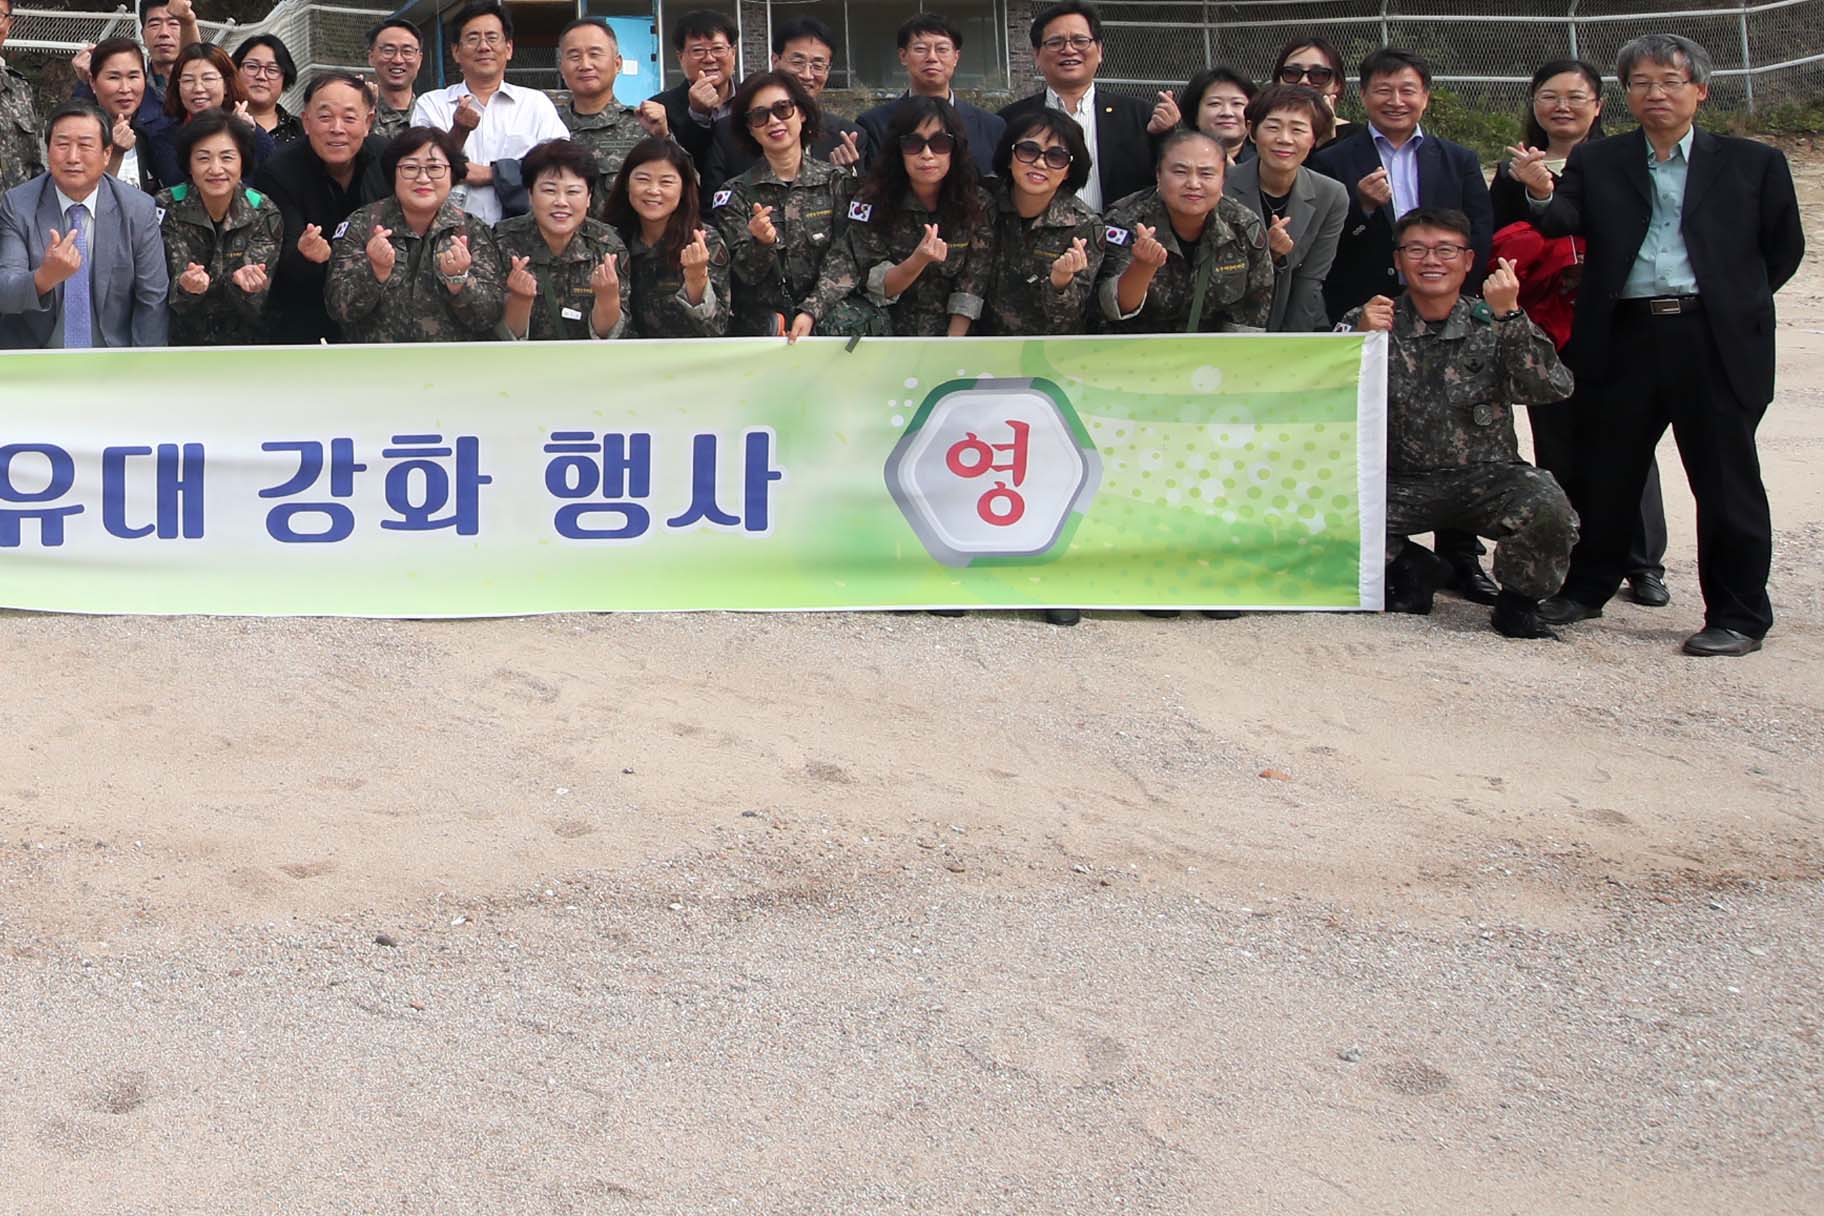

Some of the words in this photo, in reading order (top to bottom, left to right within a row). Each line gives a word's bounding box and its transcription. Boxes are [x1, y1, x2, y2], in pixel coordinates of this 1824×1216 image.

[258, 434, 493, 544] 강화
[543, 431, 782, 540] 행사
[946, 419, 1031, 527] 영
